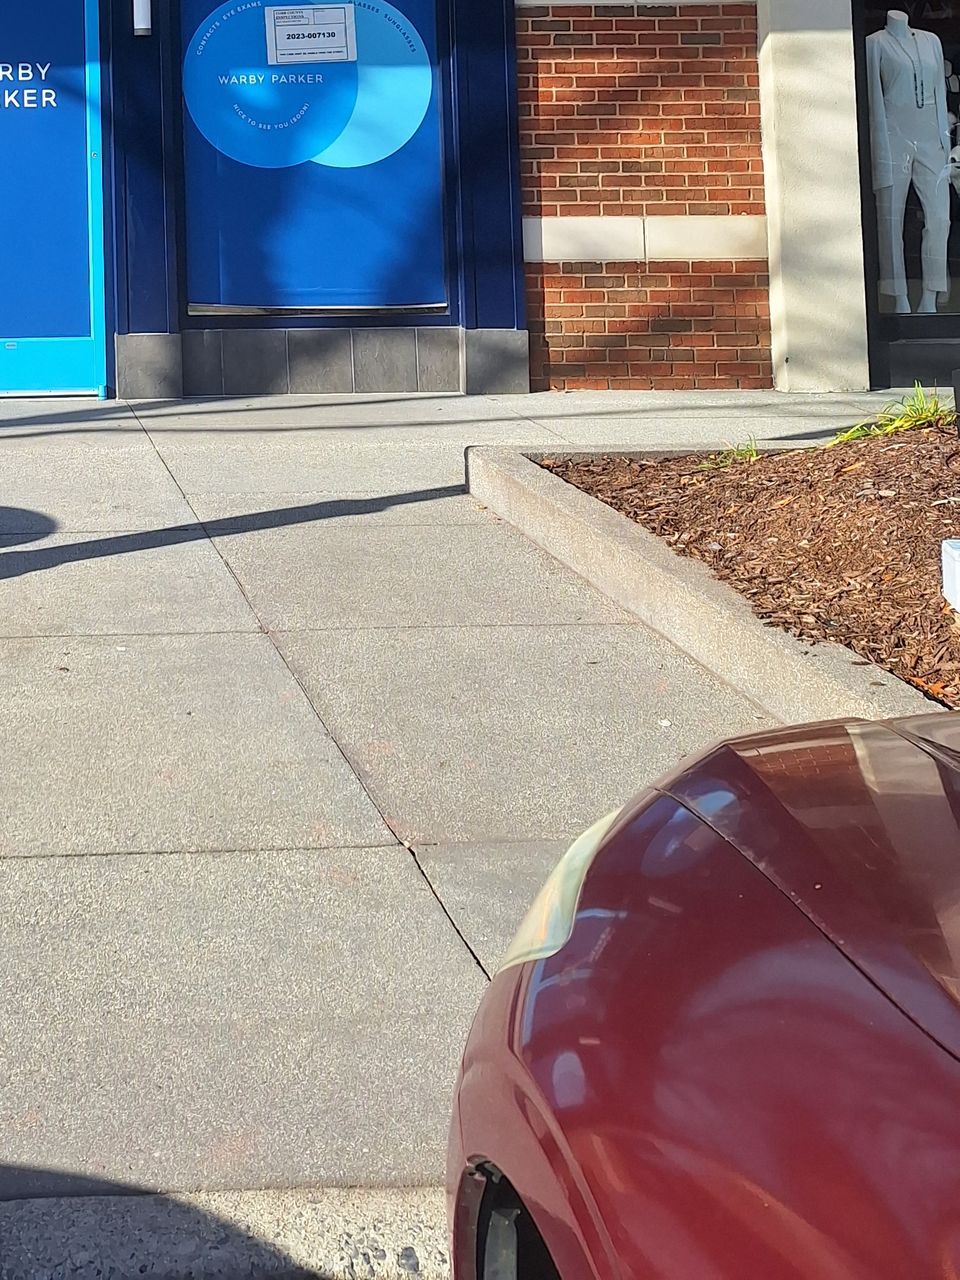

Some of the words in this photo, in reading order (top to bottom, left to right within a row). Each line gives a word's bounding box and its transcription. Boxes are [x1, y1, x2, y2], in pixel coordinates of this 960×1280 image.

[196, 20, 220, 56] CONTACTS
[222, 9, 236, 21] EYE
[237, 0, 262, 12] EXAMS
[286, 31, 337, 40] 2023-007130
[383, 13, 417, 53] SUNGLASSES
[217, 74, 265, 85] WARBY
[271, 74, 324, 84] PARKER
[233, 103, 247, 120] NICE
[247, 118, 256, 126] TO
[290, 102, 310, 125] (SOON)
